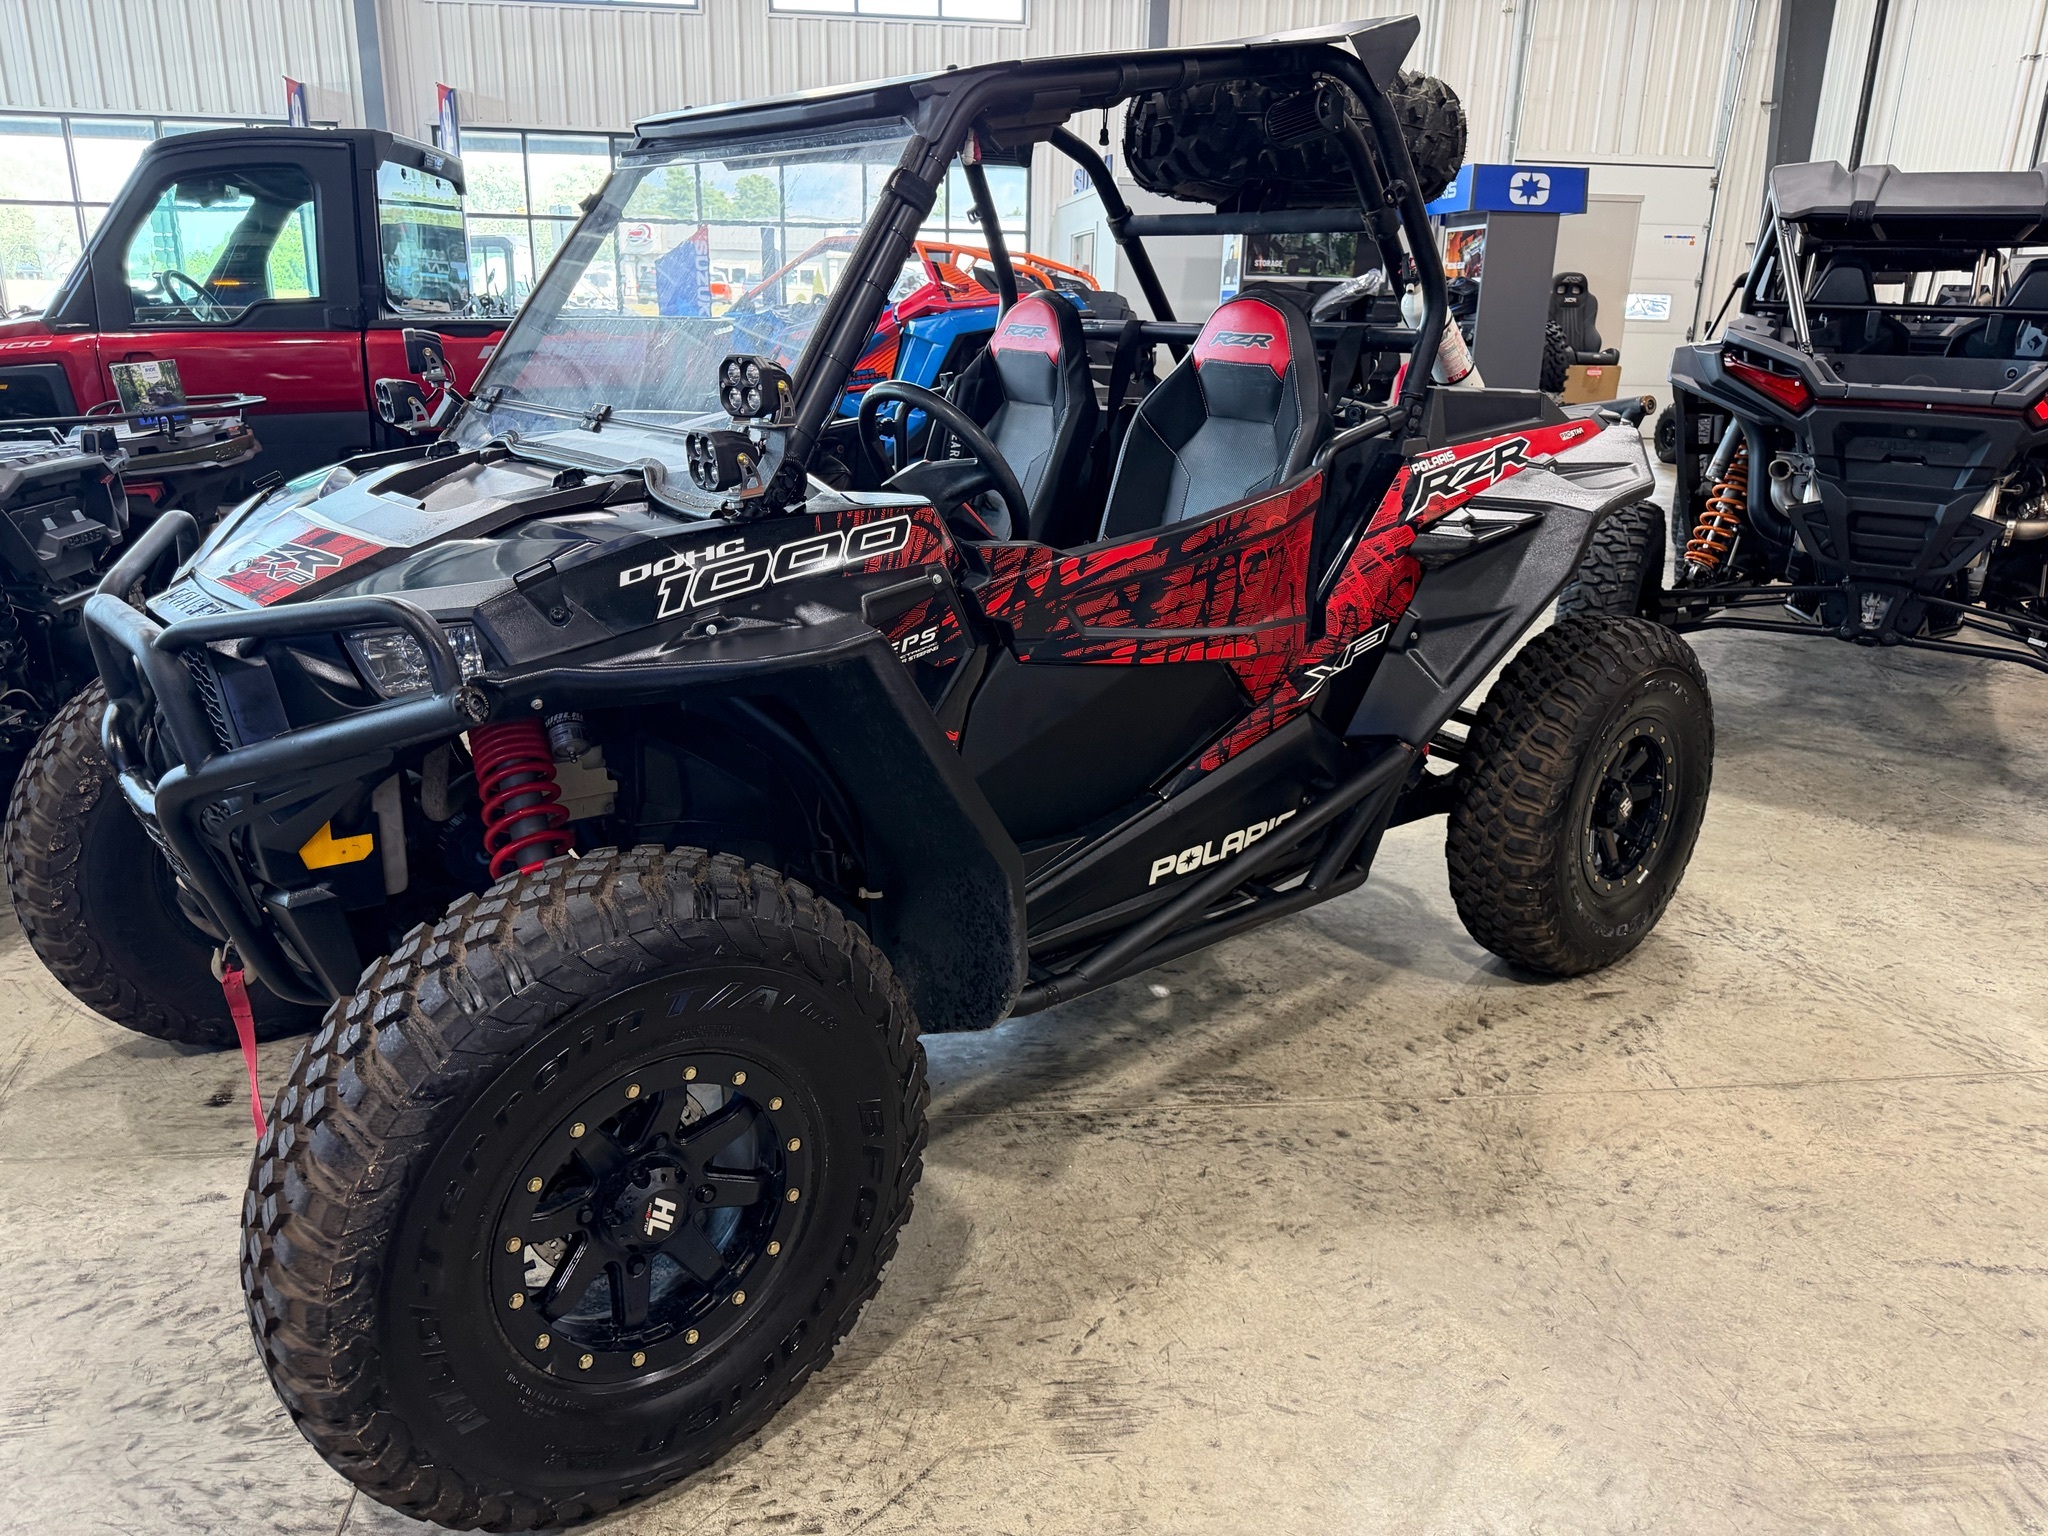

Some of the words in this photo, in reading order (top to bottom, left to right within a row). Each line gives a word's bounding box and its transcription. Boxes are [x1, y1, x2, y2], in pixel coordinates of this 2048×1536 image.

[693, 238, 712, 317] SUZUK
[1254, 259, 1284, 268] STORAGE
[1002, 323, 1049, 340] RZR
[1209, 331, 1275, 349] RZR
[1404, 435, 1531, 522] RZR
[1411, 450, 1457, 475] POLARIS
[619, 537, 746, 588] DOHC
[656, 514, 913, 620] 1000
[908, 645, 939, 662] STEERING
[1297, 622, 1391, 702] XP
[663, 982, 781, 1019] T/A
[646, 1197, 677, 1237] HL
